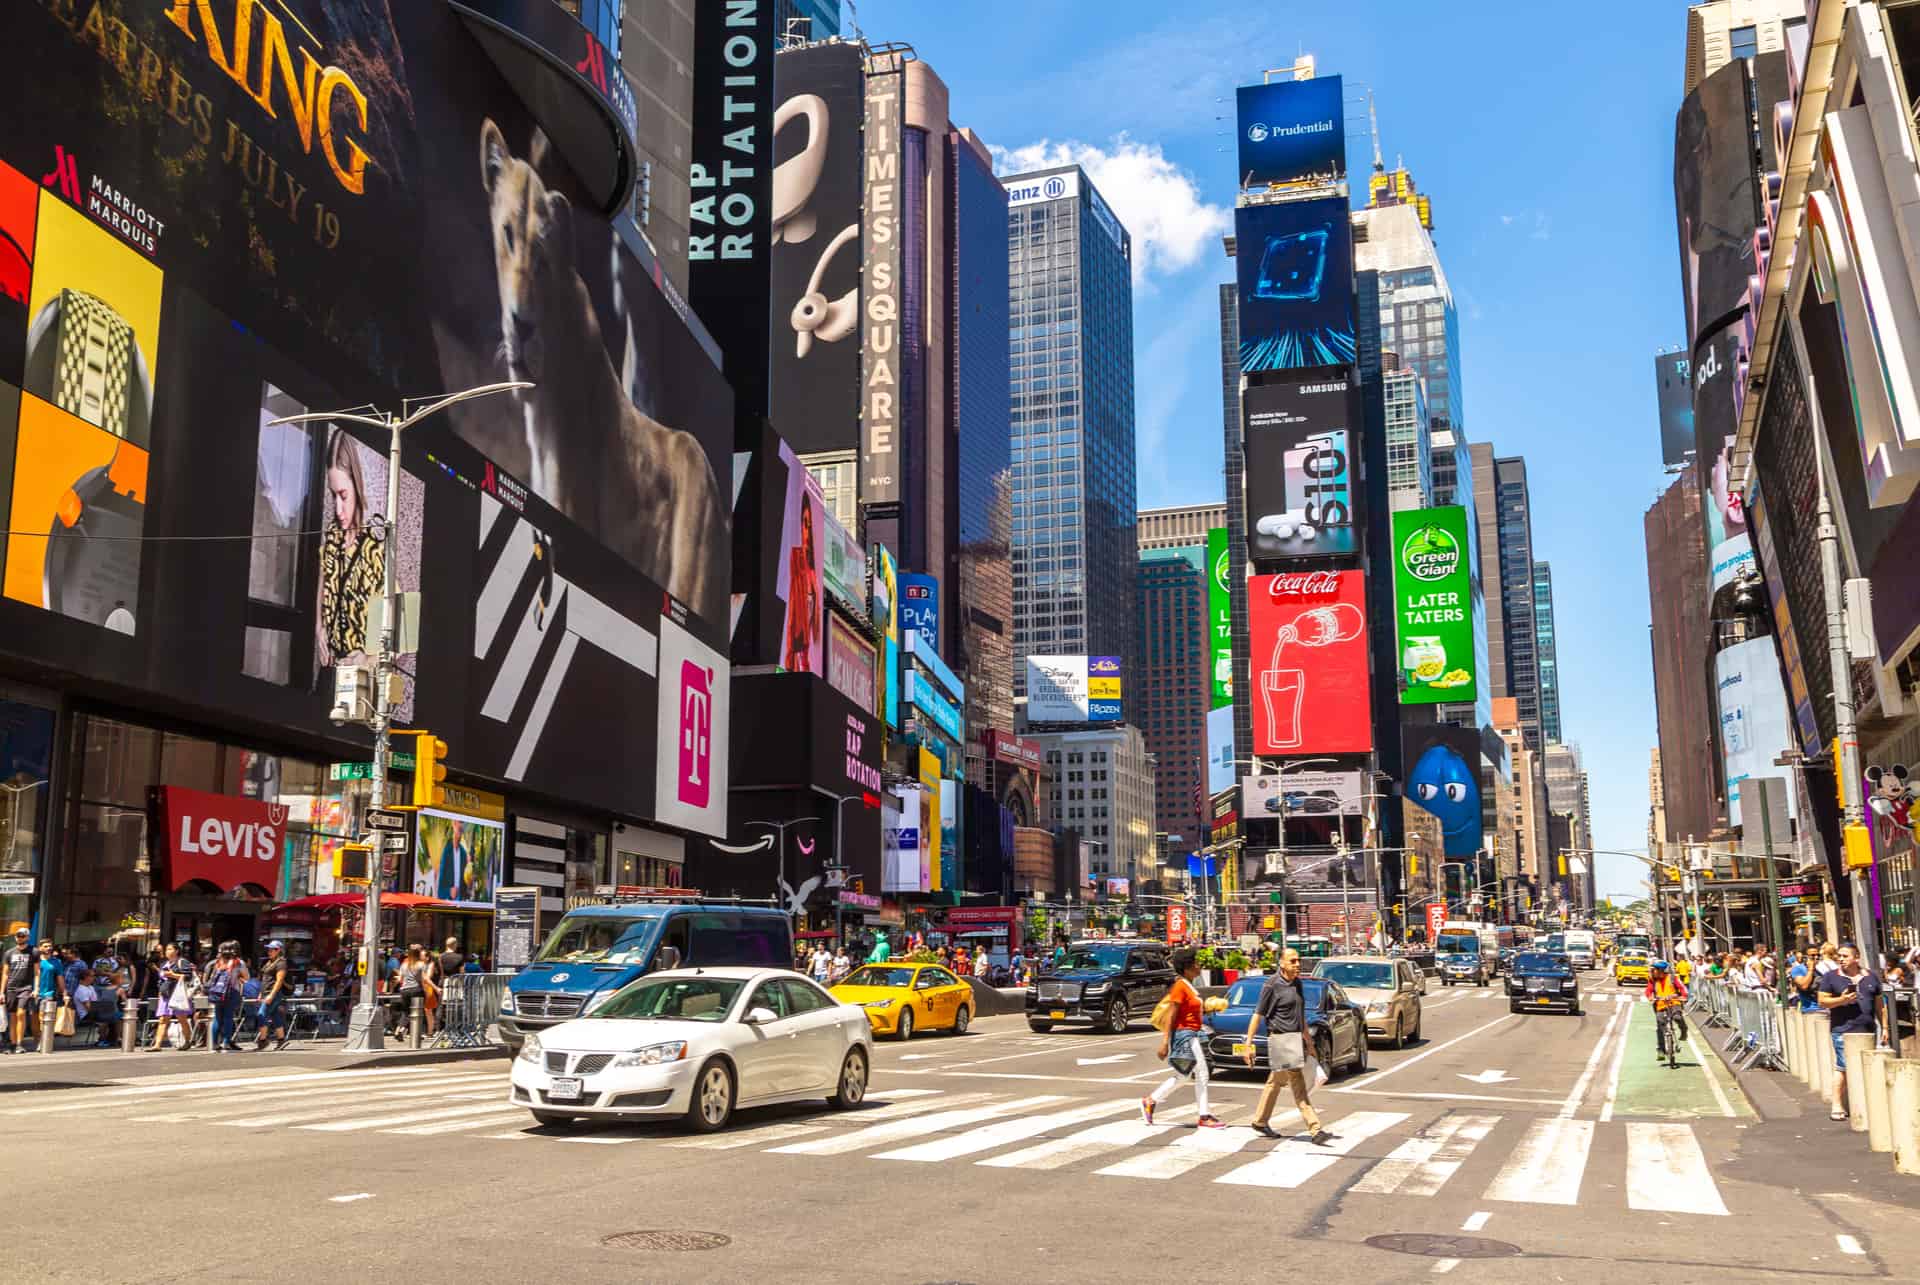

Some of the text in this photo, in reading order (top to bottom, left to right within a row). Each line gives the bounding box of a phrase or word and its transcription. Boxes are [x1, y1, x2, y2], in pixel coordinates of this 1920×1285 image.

[720, 0, 757, 260] ROTATION
[1272, 120, 1333, 137] Prudential
[92, 174, 165, 237] MARRIOTT
[688, 162, 717, 261] RAP
[90, 195, 155, 252] MARQUIS
[867, 93, 897, 454] TIMES SQUARE
[1300, 383, 1347, 394] SAMSUNG
[870, 477, 891, 487] NYC
[1409, 551, 1457, 565] Green
[1415, 563, 1457, 577] Giant
[1408, 592, 1459, 609] LATER
[1404, 608, 1464, 625] TATERS
[1090, 704, 1120, 714] FROZEN
[847, 729, 861, 758] RAP
[352, 766, 364, 777] 45
[847, 754, 881, 792] ROTATION
[180, 815, 276, 862] Levi's
